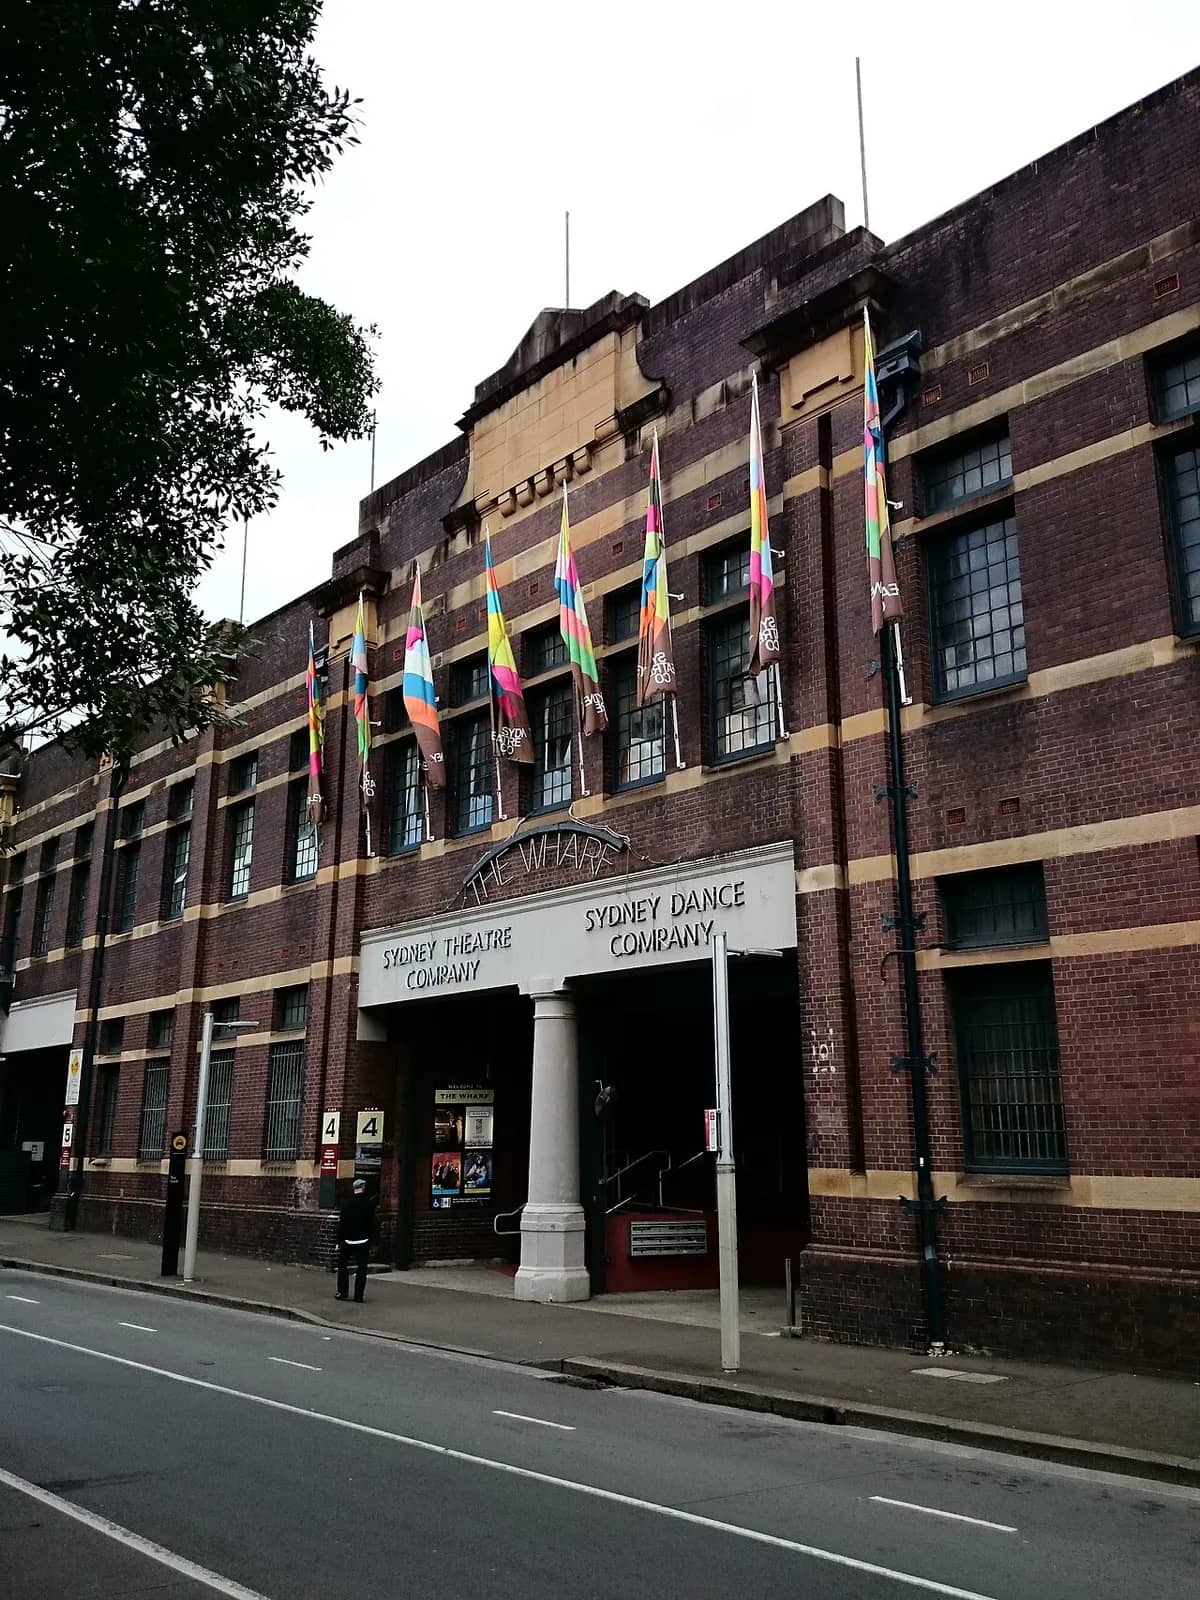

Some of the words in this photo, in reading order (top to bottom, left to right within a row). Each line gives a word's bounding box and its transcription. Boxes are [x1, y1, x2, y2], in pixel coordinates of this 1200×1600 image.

[466, 848, 514, 905] THE
[518, 832, 620, 877] WHARF
[584, 893, 660, 931] SYDNEY
[669, 881, 746, 915] DANCE
[382, 939, 438, 969] SYDNEY
[443, 926, 512, 956] THEATRE
[610, 919, 716, 958] COMPANY
[406, 959, 481, 989] COMPANY
[64, 1128, 70, 1142] 5
[325, 1118, 336, 1138] 4
[361, 1117, 378, 1137] 4
